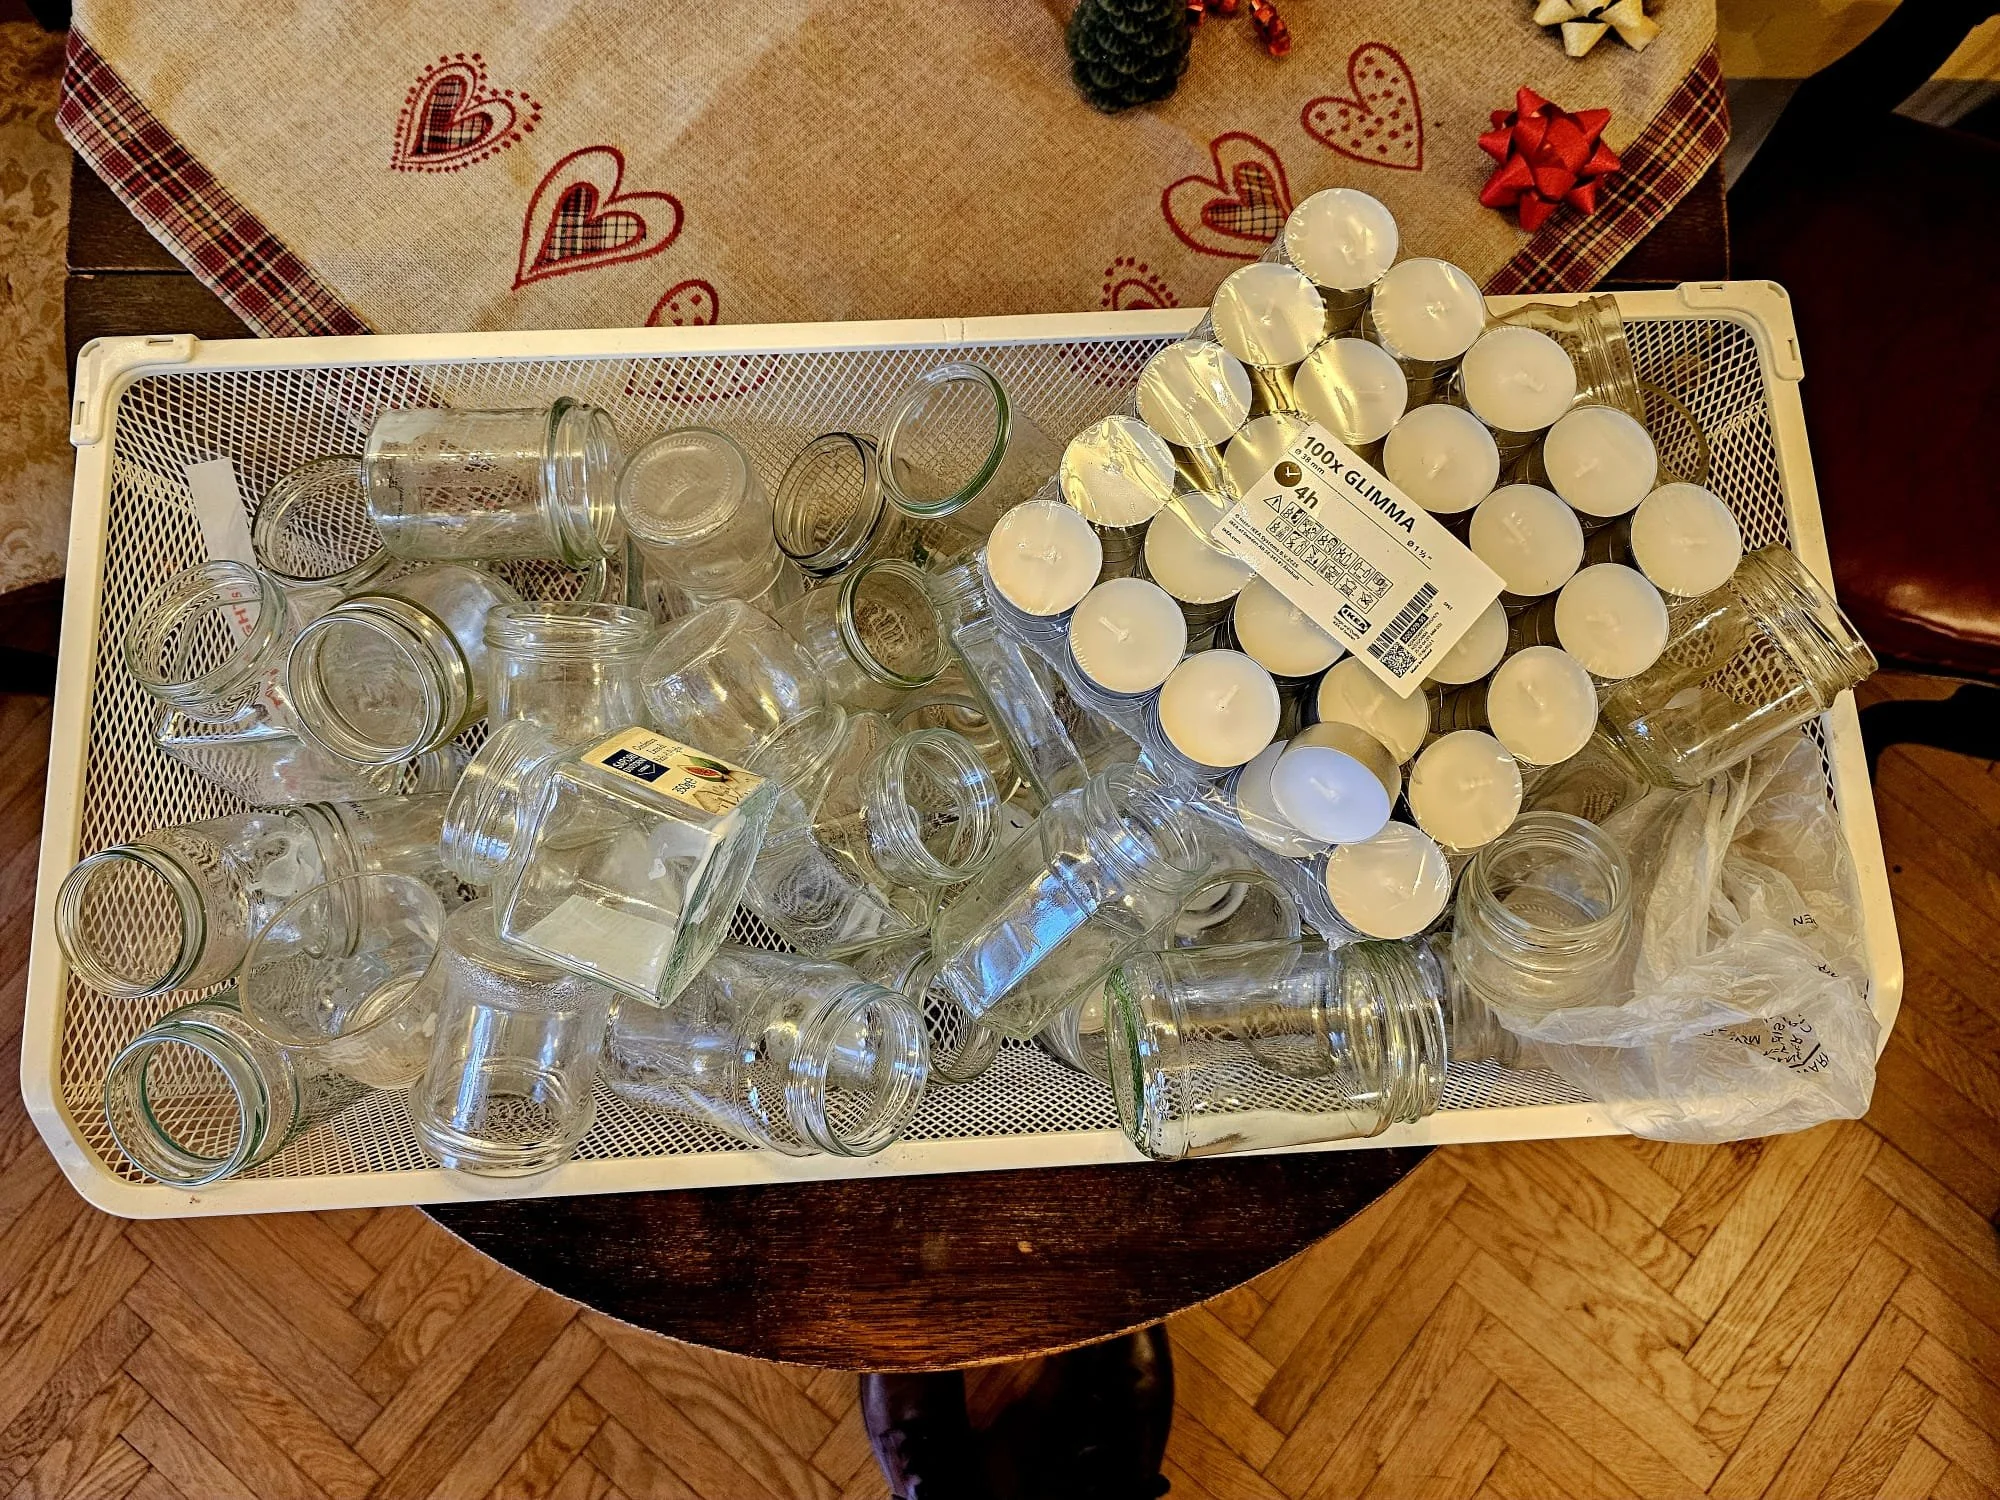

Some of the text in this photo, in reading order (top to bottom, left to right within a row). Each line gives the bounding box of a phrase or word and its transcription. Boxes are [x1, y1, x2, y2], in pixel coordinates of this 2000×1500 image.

[1301, 453, 1311, 463] 38
[1311, 461, 1325, 475] mm
[1303, 436, 1416, 534] 100x GLIMMA
[1294, 486, 1319, 510] 4h
[1222, 528, 1241, 545] IKEA.com
[1250, 526, 1262, 537] IKEA
[1260, 535, 1279, 552] Systems
[1343, 609, 1366, 629] IKEA
